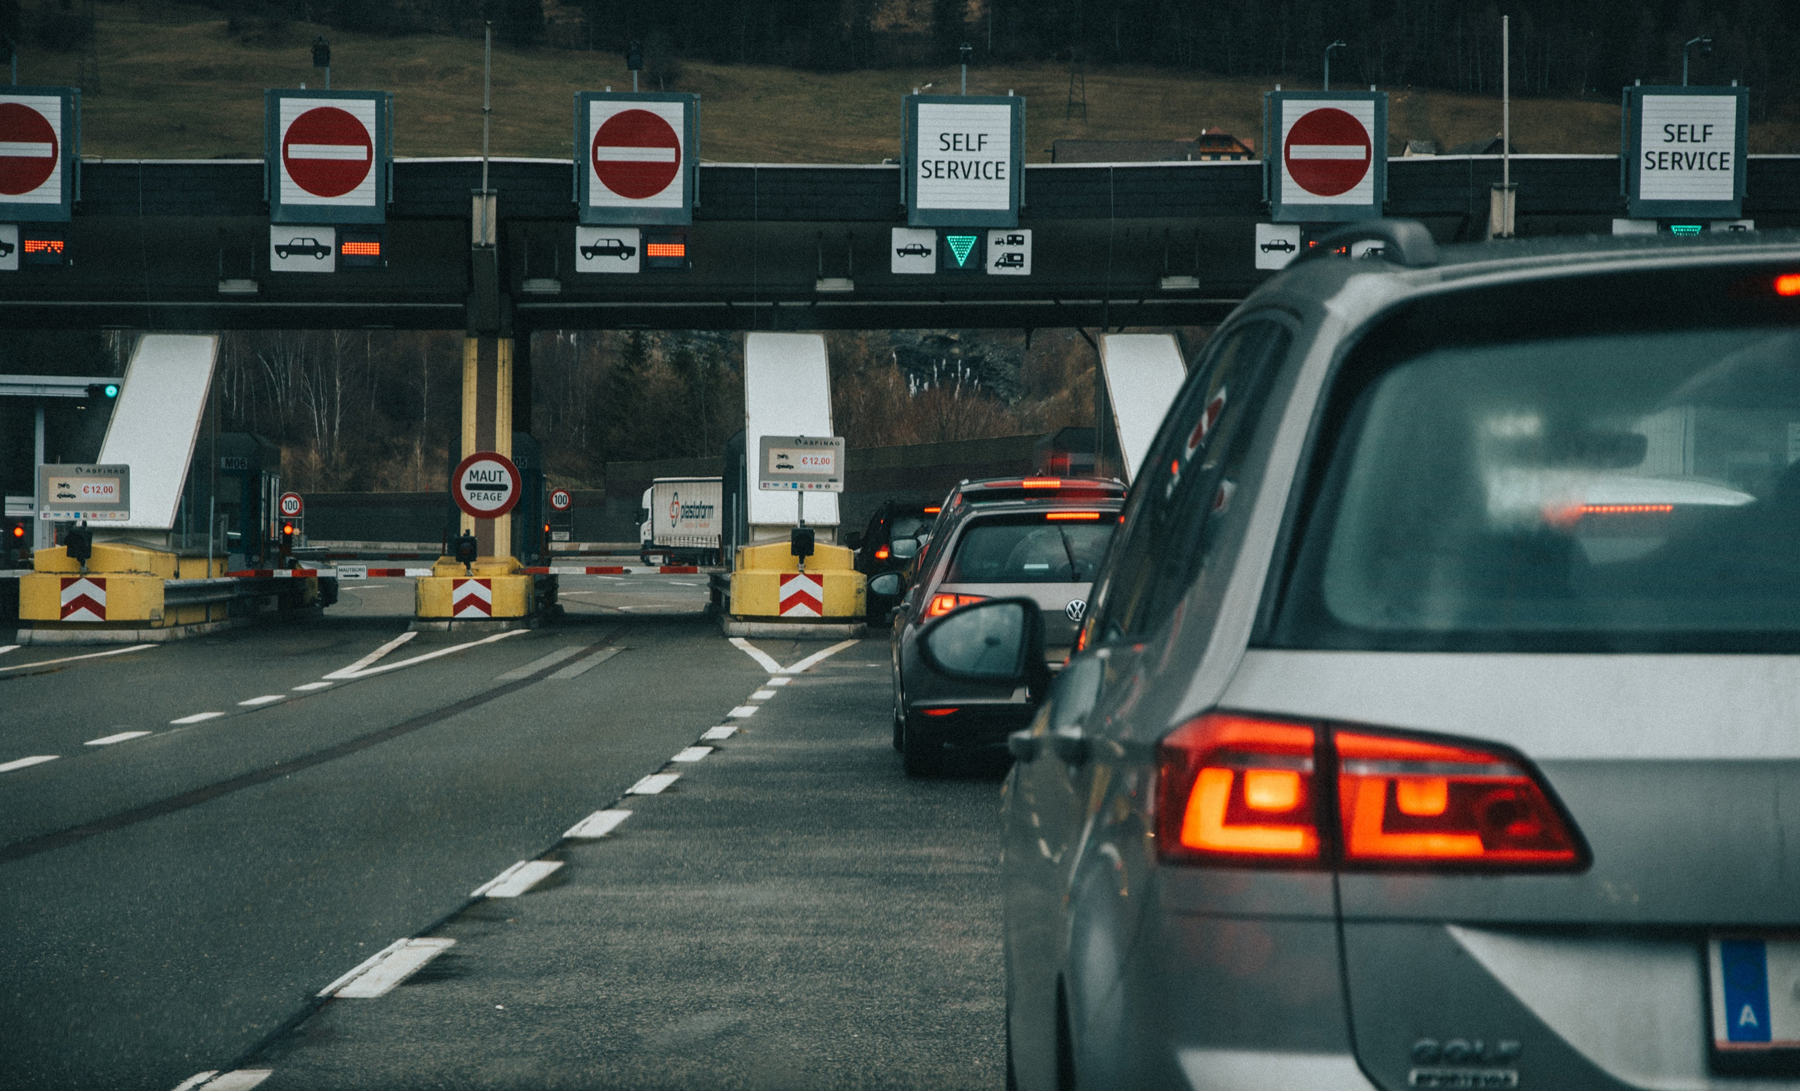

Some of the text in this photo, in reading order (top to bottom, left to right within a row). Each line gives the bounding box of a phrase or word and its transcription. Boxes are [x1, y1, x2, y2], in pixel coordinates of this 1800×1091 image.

[1663, 123, 1714, 143] SELF
[939, 132, 989, 152] SELF
[1644, 150, 1731, 171] SERVICE
[921, 159, 1006, 180] SERVICE
[810, 457, 831, 466] 12,00
[469, 470, 504, 482] MAUT
[91, 485, 114, 495] 12,00
[470, 492, 503, 501] PEAGE
[554, 495, 568, 505] 100
[284, 500, 298, 511] 100
[1739, 1004, 1758, 1026] A
